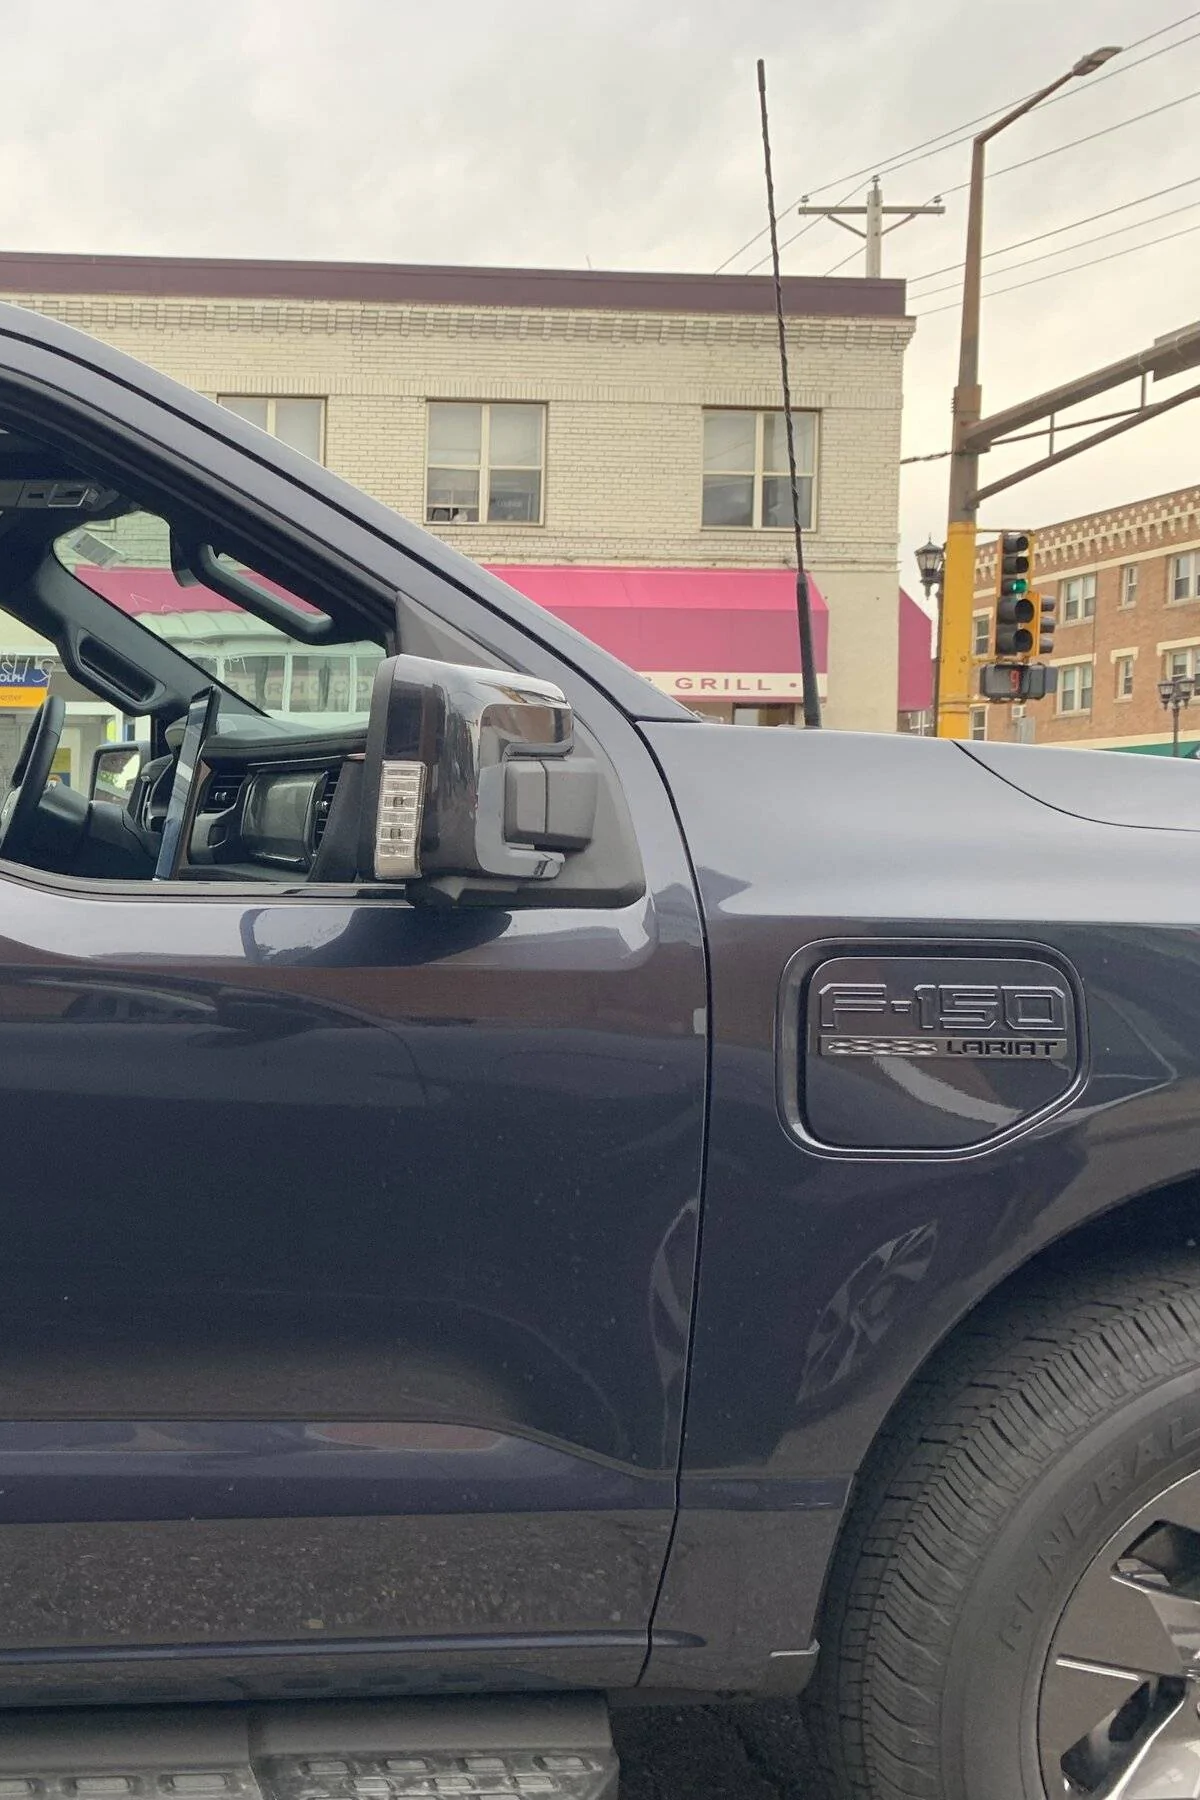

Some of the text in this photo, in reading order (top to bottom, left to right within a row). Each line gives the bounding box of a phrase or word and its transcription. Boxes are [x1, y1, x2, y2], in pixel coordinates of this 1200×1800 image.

[674, 677, 773, 691] GRILL
[818, 983, 1066, 1031] F-150
[945, 1039, 1059, 1057] LARIAT
